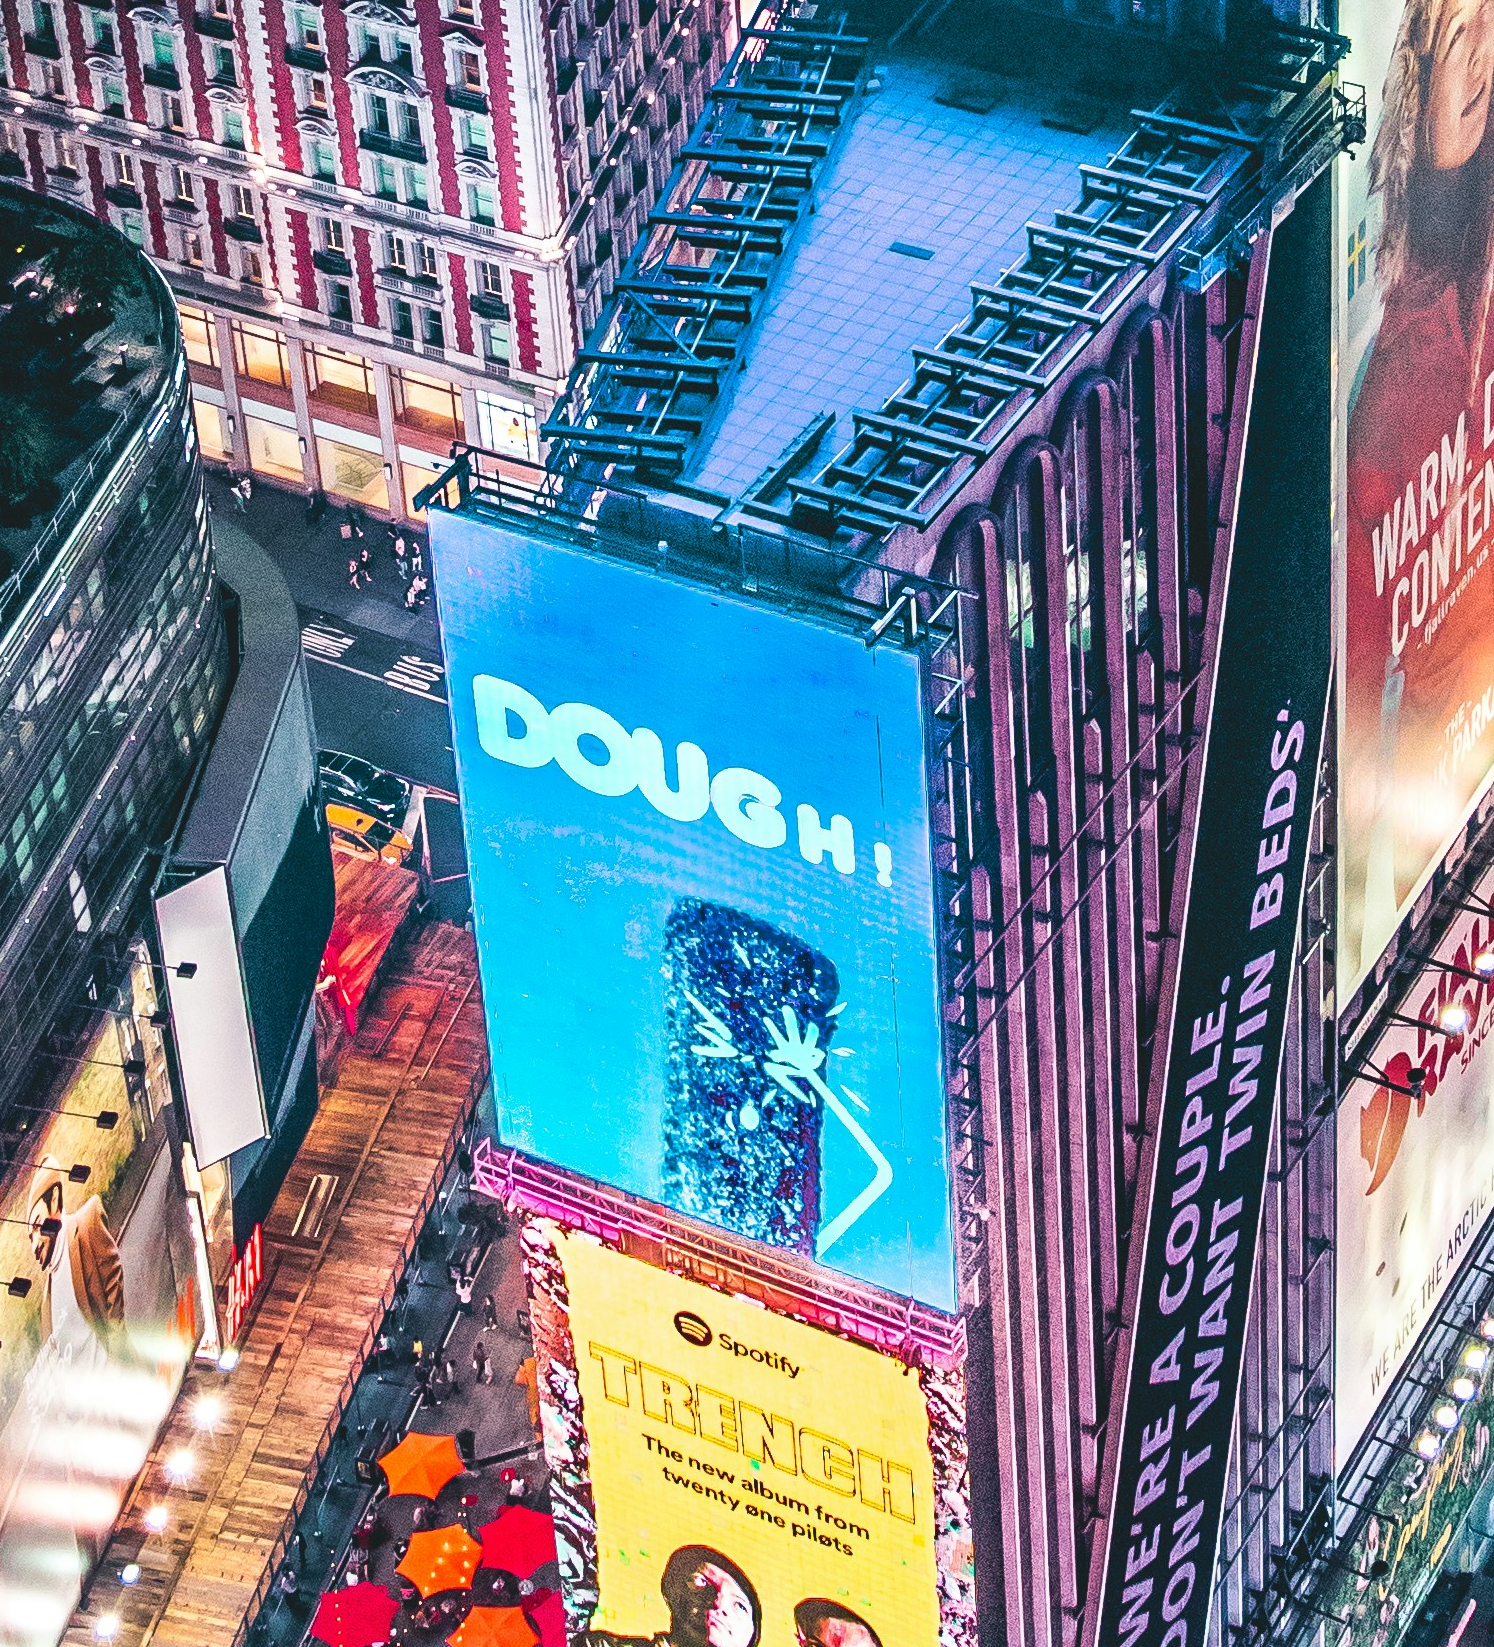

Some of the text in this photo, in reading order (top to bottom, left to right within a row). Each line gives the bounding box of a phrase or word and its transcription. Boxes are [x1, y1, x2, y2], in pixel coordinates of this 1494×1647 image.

[1370, 411, 1472, 597] WARM.
[385, 656, 445, 696] BUS
[1158, 973, 1231, 1315] COUPLE.
[1186, 1198, 1242, 1427] WANT
[1219, 950, 1275, 1170] TWIN
[719, 1331, 801, 1380] Spotify
[1149, 1330, 1184, 1384] A
[588, 1341, 916, 1525] TRENCH
[642, 1431, 871, 1541] The new album from
[662, 1464, 854, 1559] twenty øne piløts
